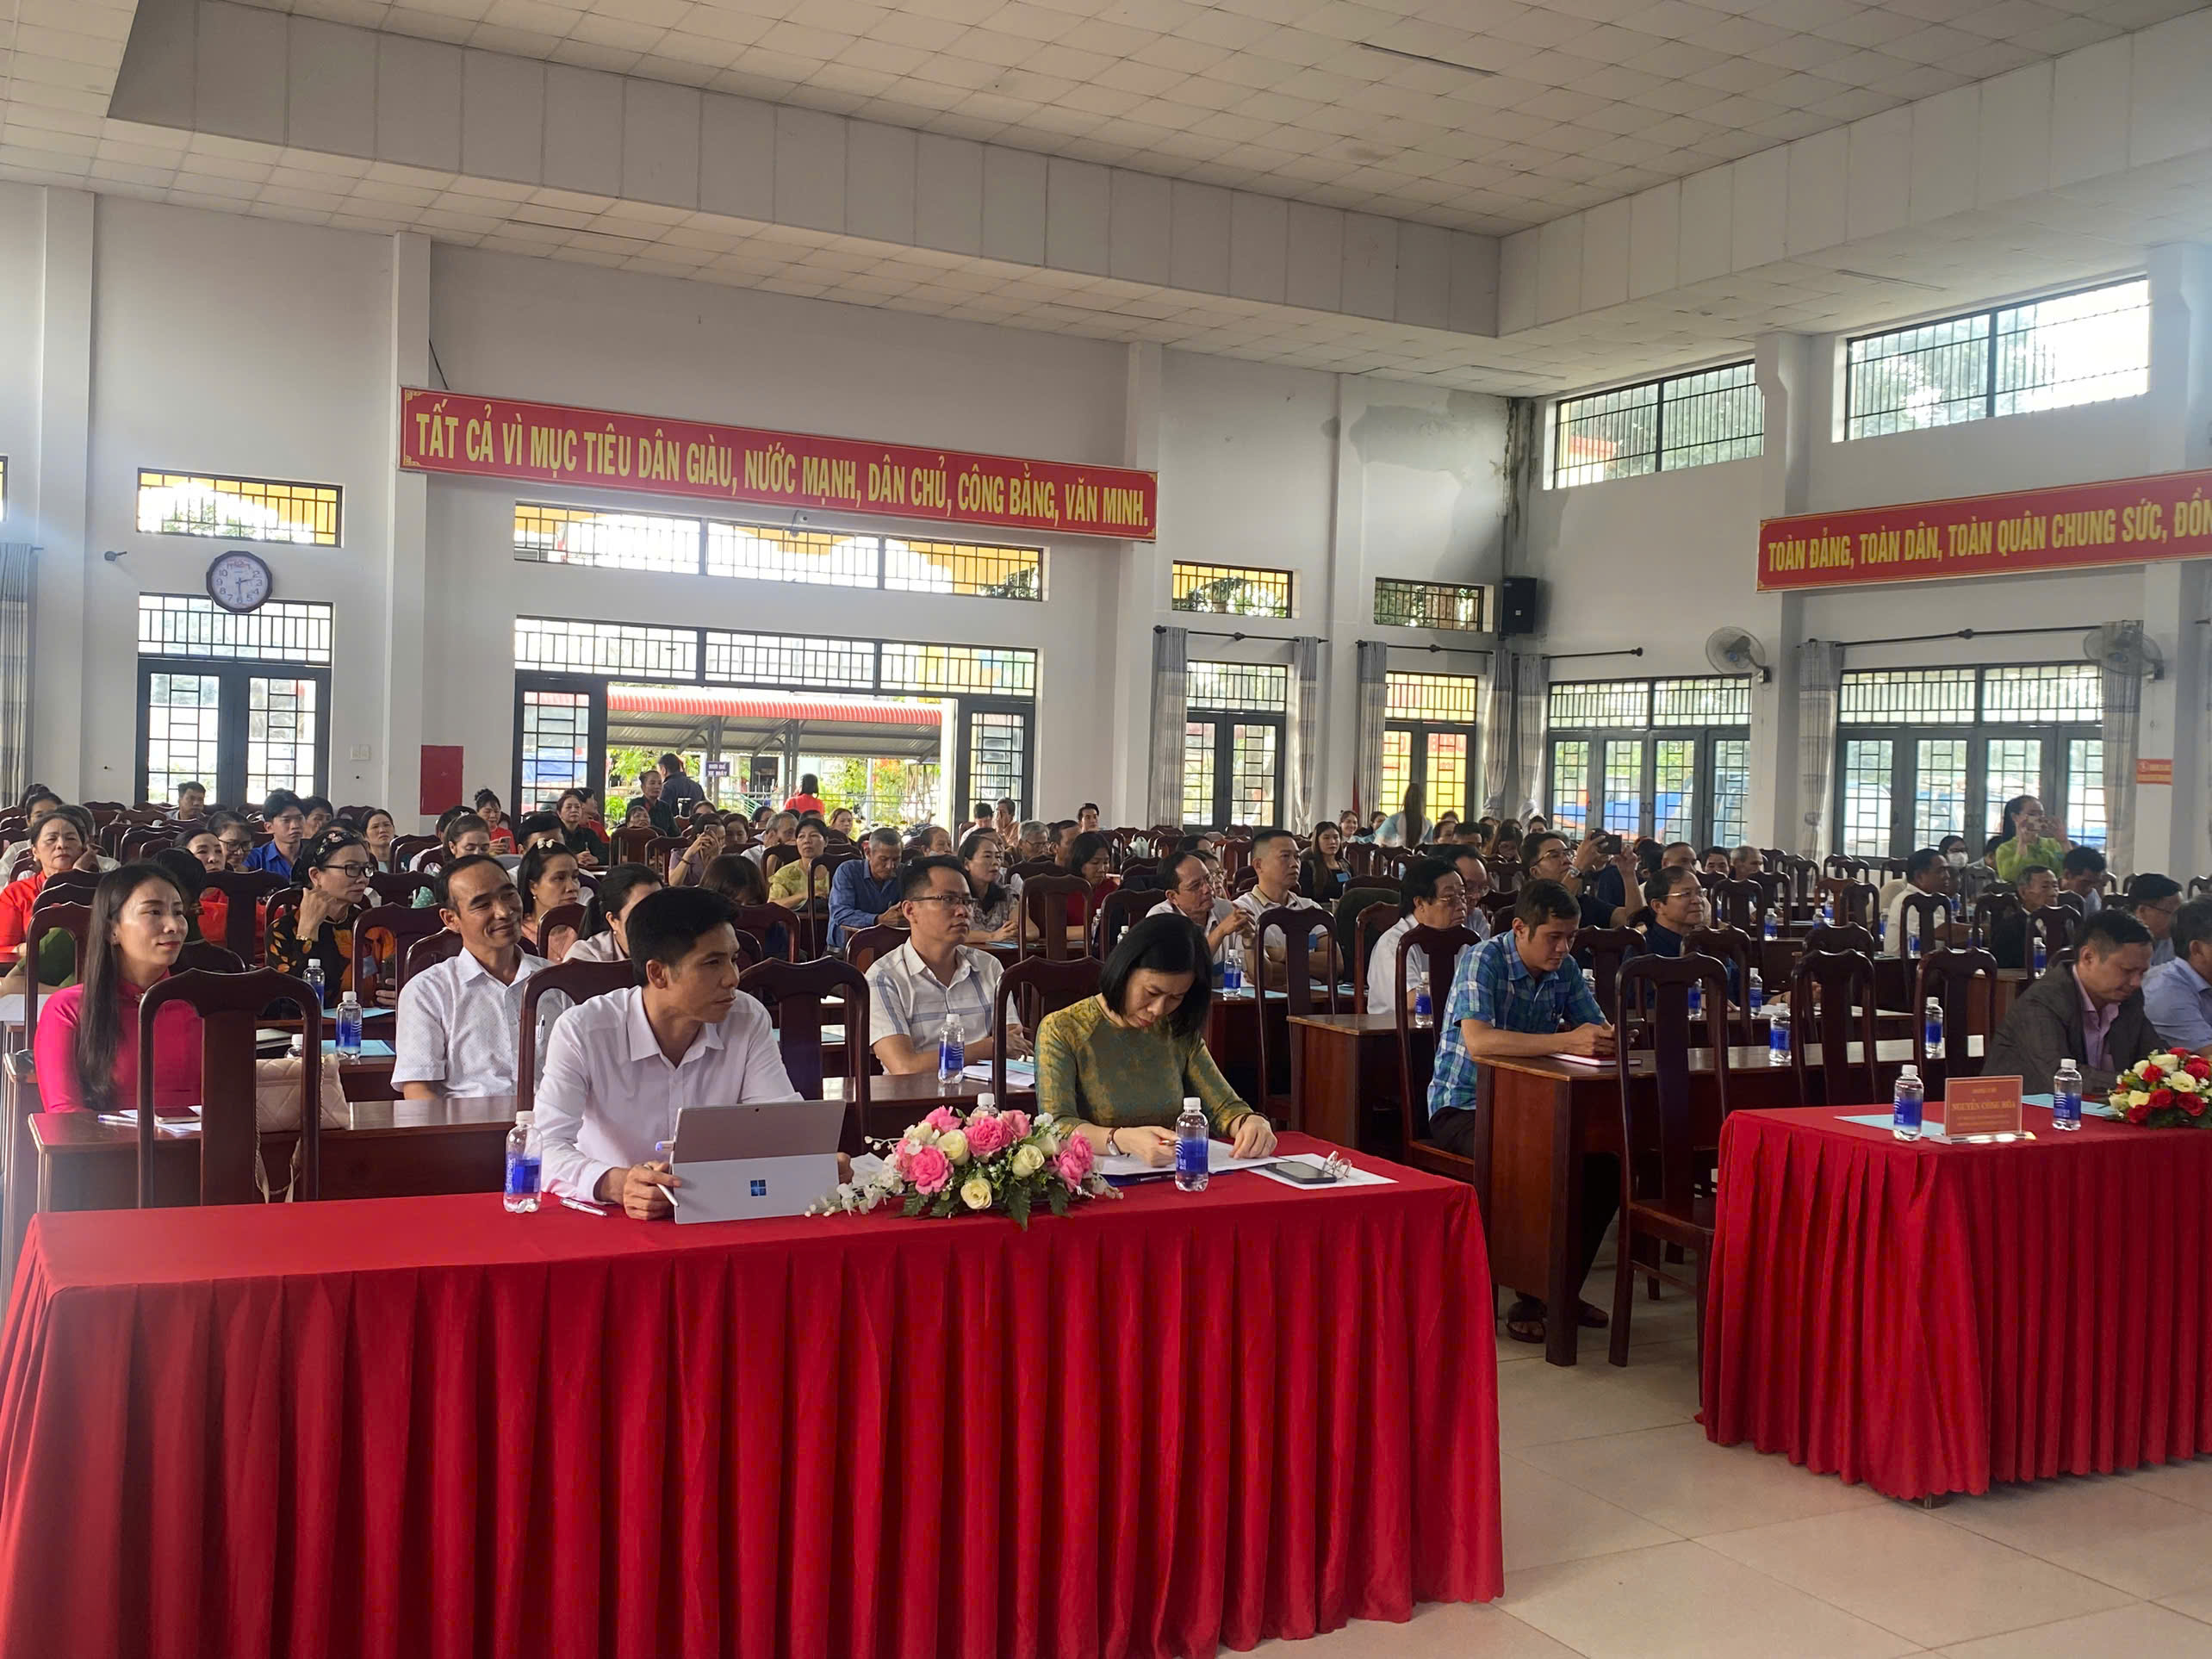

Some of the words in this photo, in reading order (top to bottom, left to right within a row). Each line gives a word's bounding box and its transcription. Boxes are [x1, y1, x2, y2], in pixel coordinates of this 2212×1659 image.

[416, 398, 459, 458] TẤT
[466, 403, 494, 463] CẢ
[502, 413, 523, 465] VÌ
[530, 426, 577, 478] MỤC
[583, 423, 631, 478] TIÊU
[639, 429, 680, 482] DÂN
[686, 434, 738, 496] GIÀU,
[745, 442, 797, 494] NƯỚC
[802, 457, 862, 508] MẠNH,
[868, 454, 905, 504] DÂN
[910, 456, 953, 517] CHỦ,
[958, 463, 1004, 515] CÔNG
[1009, 463, 1059, 527] BẰNG,
[1065, 477, 1097, 523] VĂN
[1103, 487, 1149, 526] MINH.
[1768, 533, 1806, 572] TOÀN
[1809, 526, 1855, 569] ĐẢNG,
[1860, 529, 1900, 565] TOÀN
[1904, 526, 1943, 562] DÂN,
[1948, 516, 1992, 556] TOÀN
[1998, 511, 2047, 556] QUÂN
[2052, 509, 2116, 550] CHUNG
[2122, 497, 2168, 544] SỨC,
